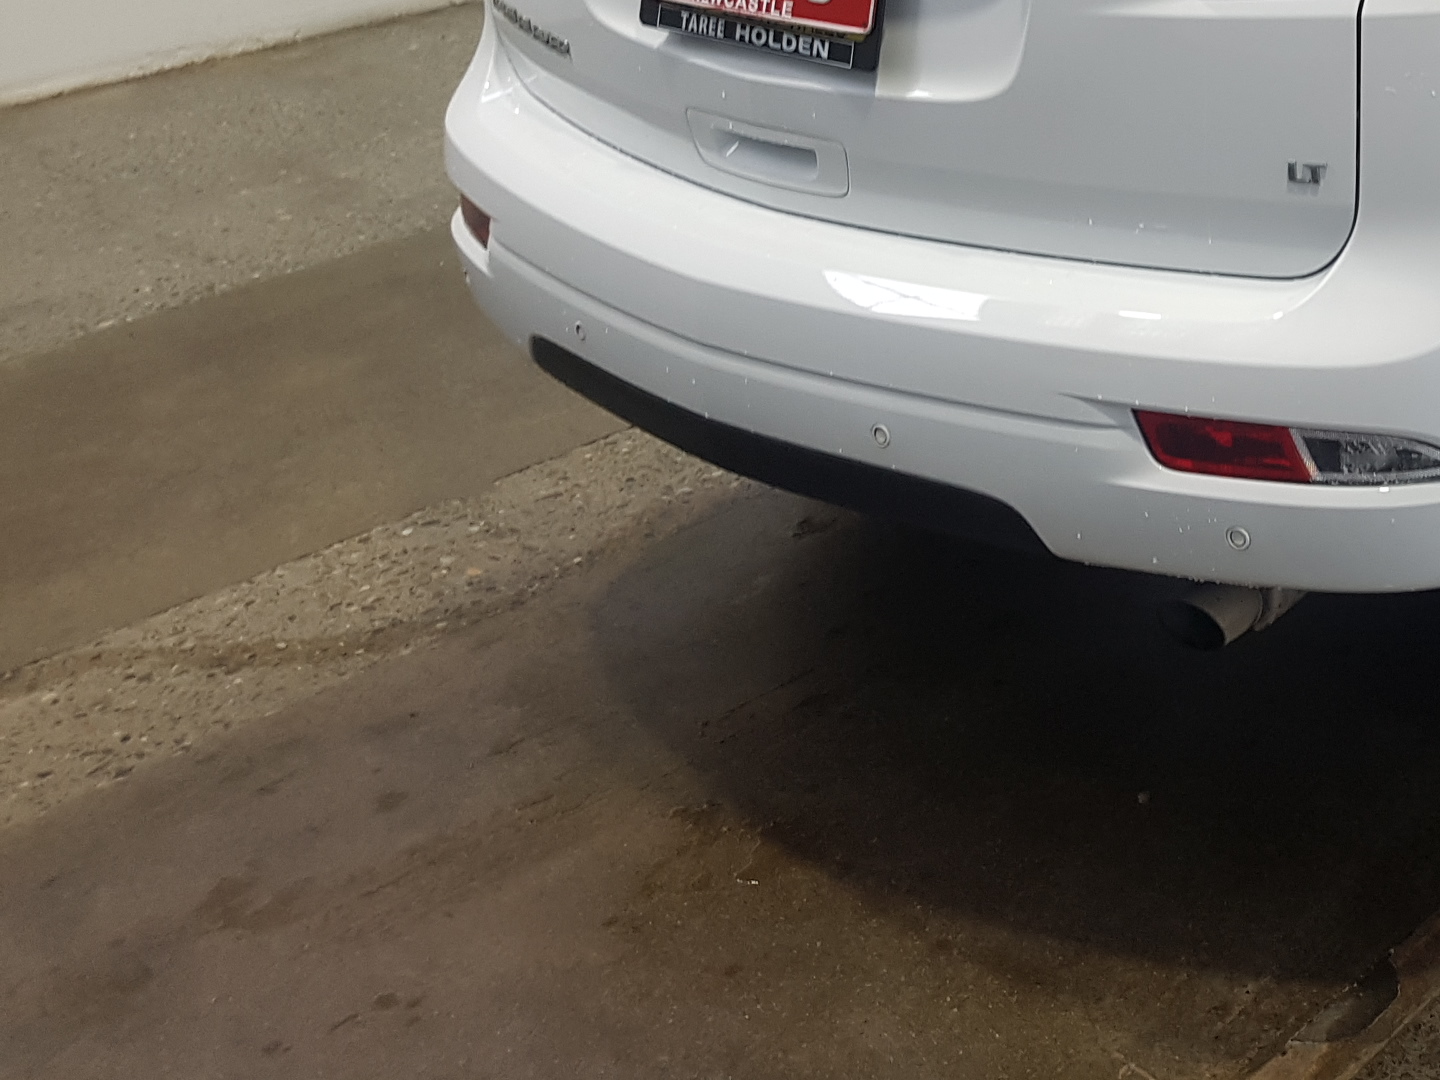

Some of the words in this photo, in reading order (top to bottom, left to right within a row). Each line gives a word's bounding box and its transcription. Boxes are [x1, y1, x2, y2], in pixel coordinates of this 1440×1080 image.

[681, 10, 725, 40] TAREE
[735, 22, 830, 60] HOLDEN
[1287, 159, 1328, 185] LT
